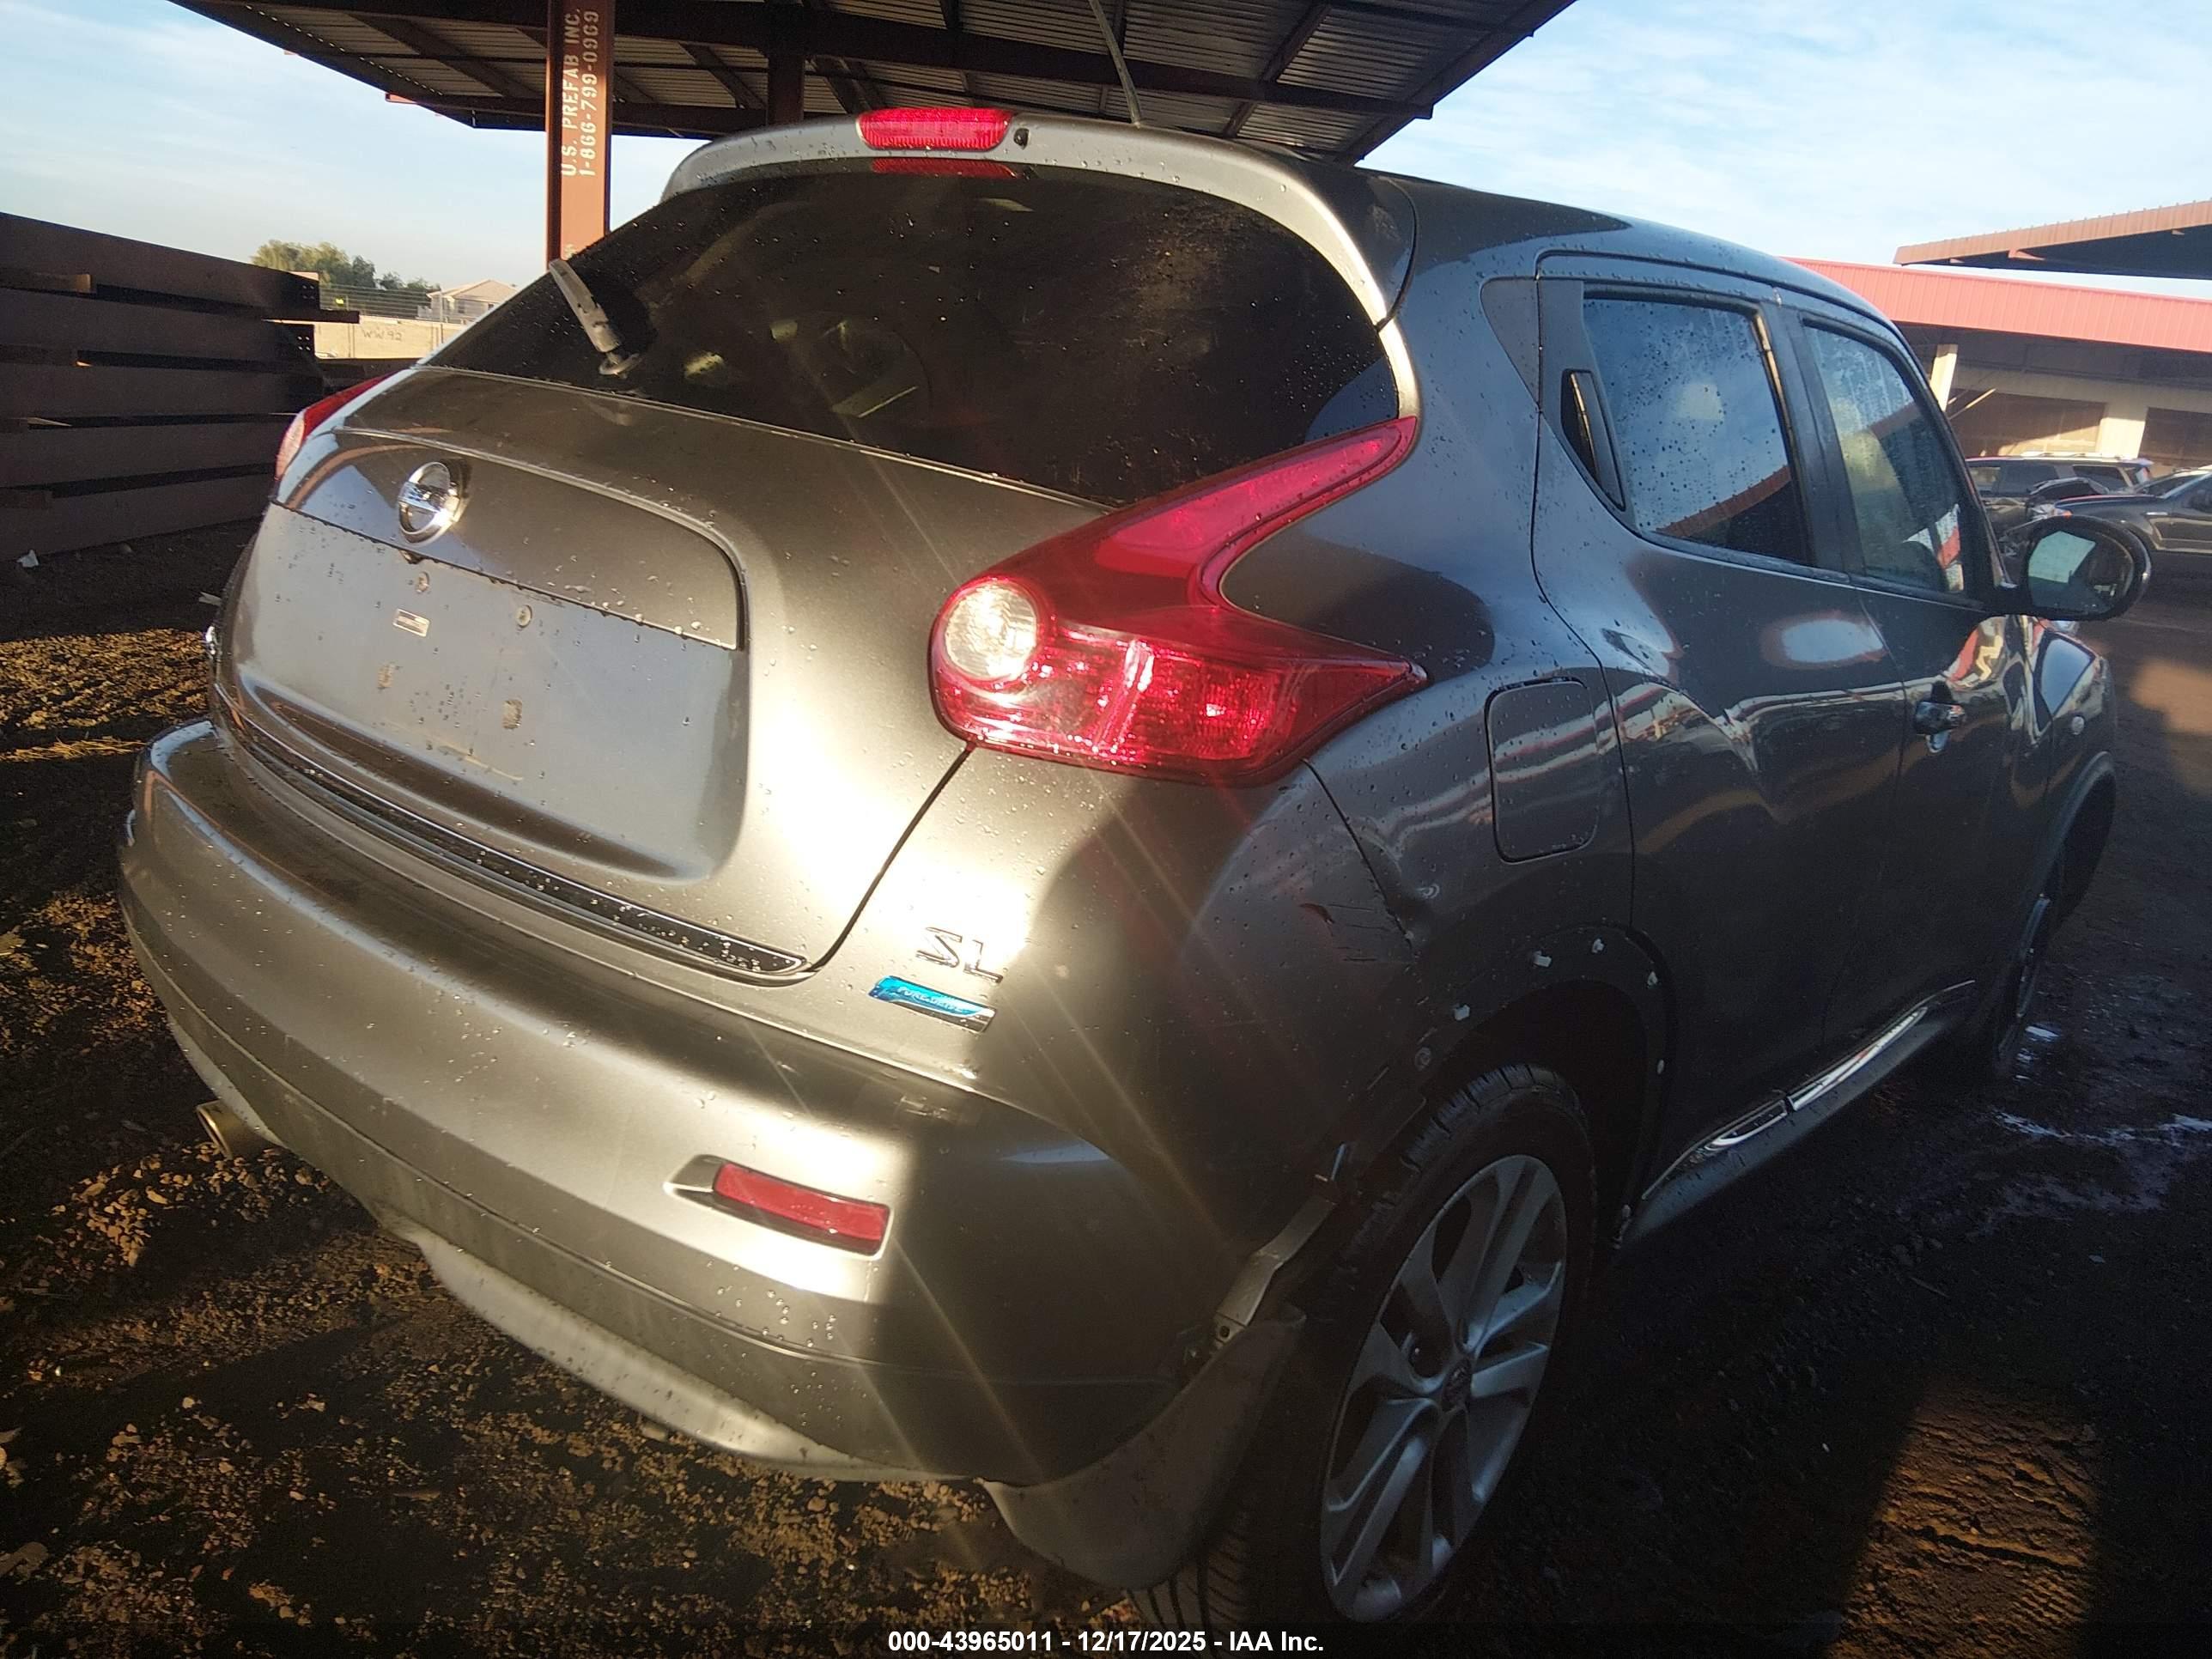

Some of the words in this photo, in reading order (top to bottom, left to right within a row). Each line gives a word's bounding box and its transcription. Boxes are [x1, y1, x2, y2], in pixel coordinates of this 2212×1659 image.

[564, 9, 580, 44] INC.
[562, 54, 579, 129] PREFAB
[579, 10, 599, 177] 1-866-799-0969
[561, 141, 577, 177] U.S.
[915, 927, 1004, 984] SL
